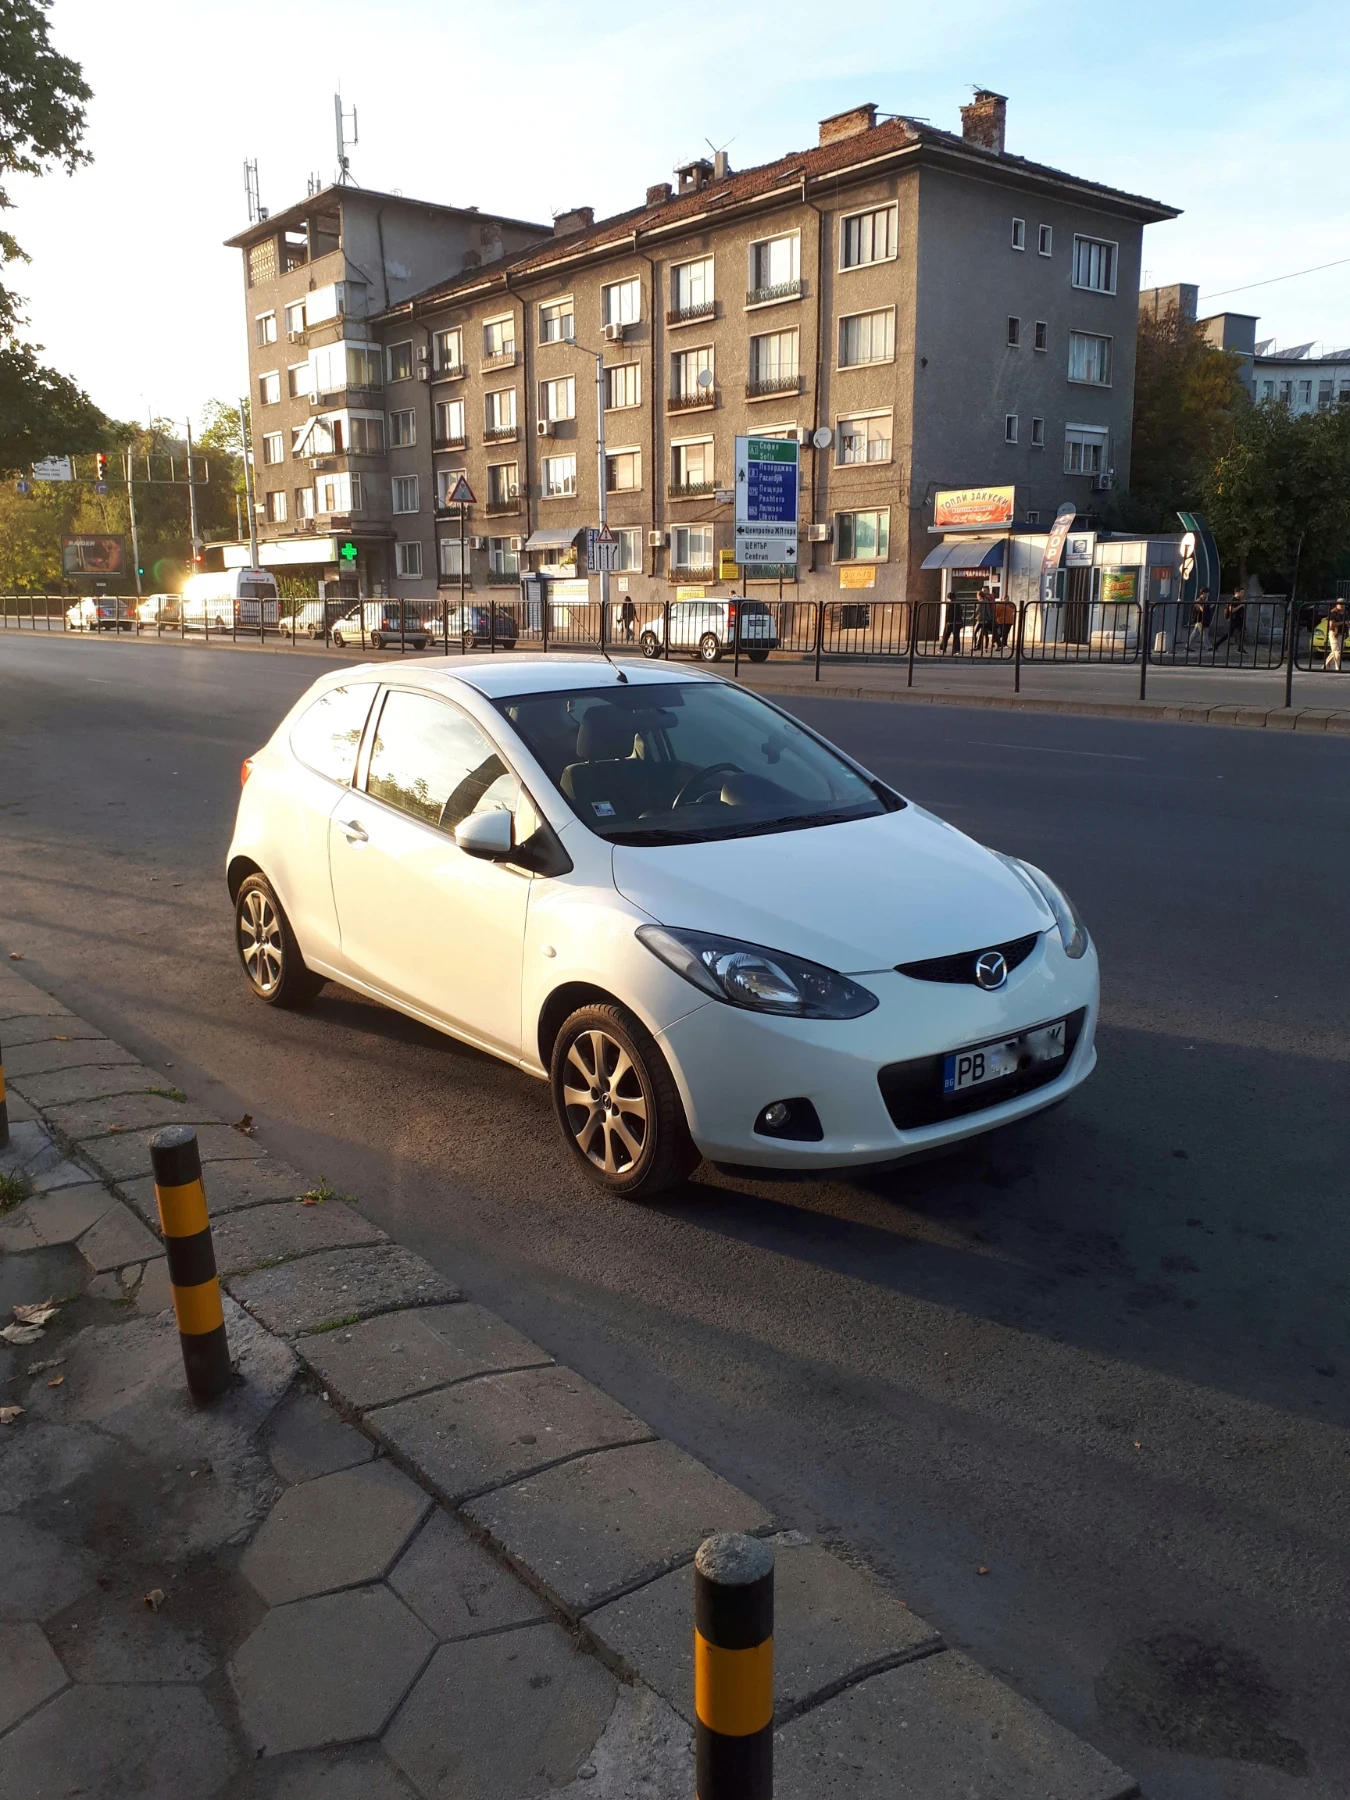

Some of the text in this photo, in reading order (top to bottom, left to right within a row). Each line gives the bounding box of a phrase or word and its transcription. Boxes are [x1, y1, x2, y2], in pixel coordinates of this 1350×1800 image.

[759, 441, 780, 451] София
[759, 452, 775, 461] Sofia
[758, 462, 793, 473] Пазарджик
[758, 473, 783, 483] Pazardjik
[758, 484, 783, 494] Пещера
[758, 494, 785, 503] Peshtera
[941, 492, 1009, 511] ТОПЛИ ЗАКУСКИ
[758, 504, 783, 513] Лилково
[758, 513, 778, 521] Lilkovo
[745, 526, 796, 536] Централна ЖП гара
[744, 541, 768, 550] ЦЕНТЪР
[1045, 514, 1071, 568] СПОРТ
[952, 569, 990, 578] БАНИЧАРНИЦА
[957, 1052, 986, 1086] PB
[944, 1078, 954, 1088] BG
